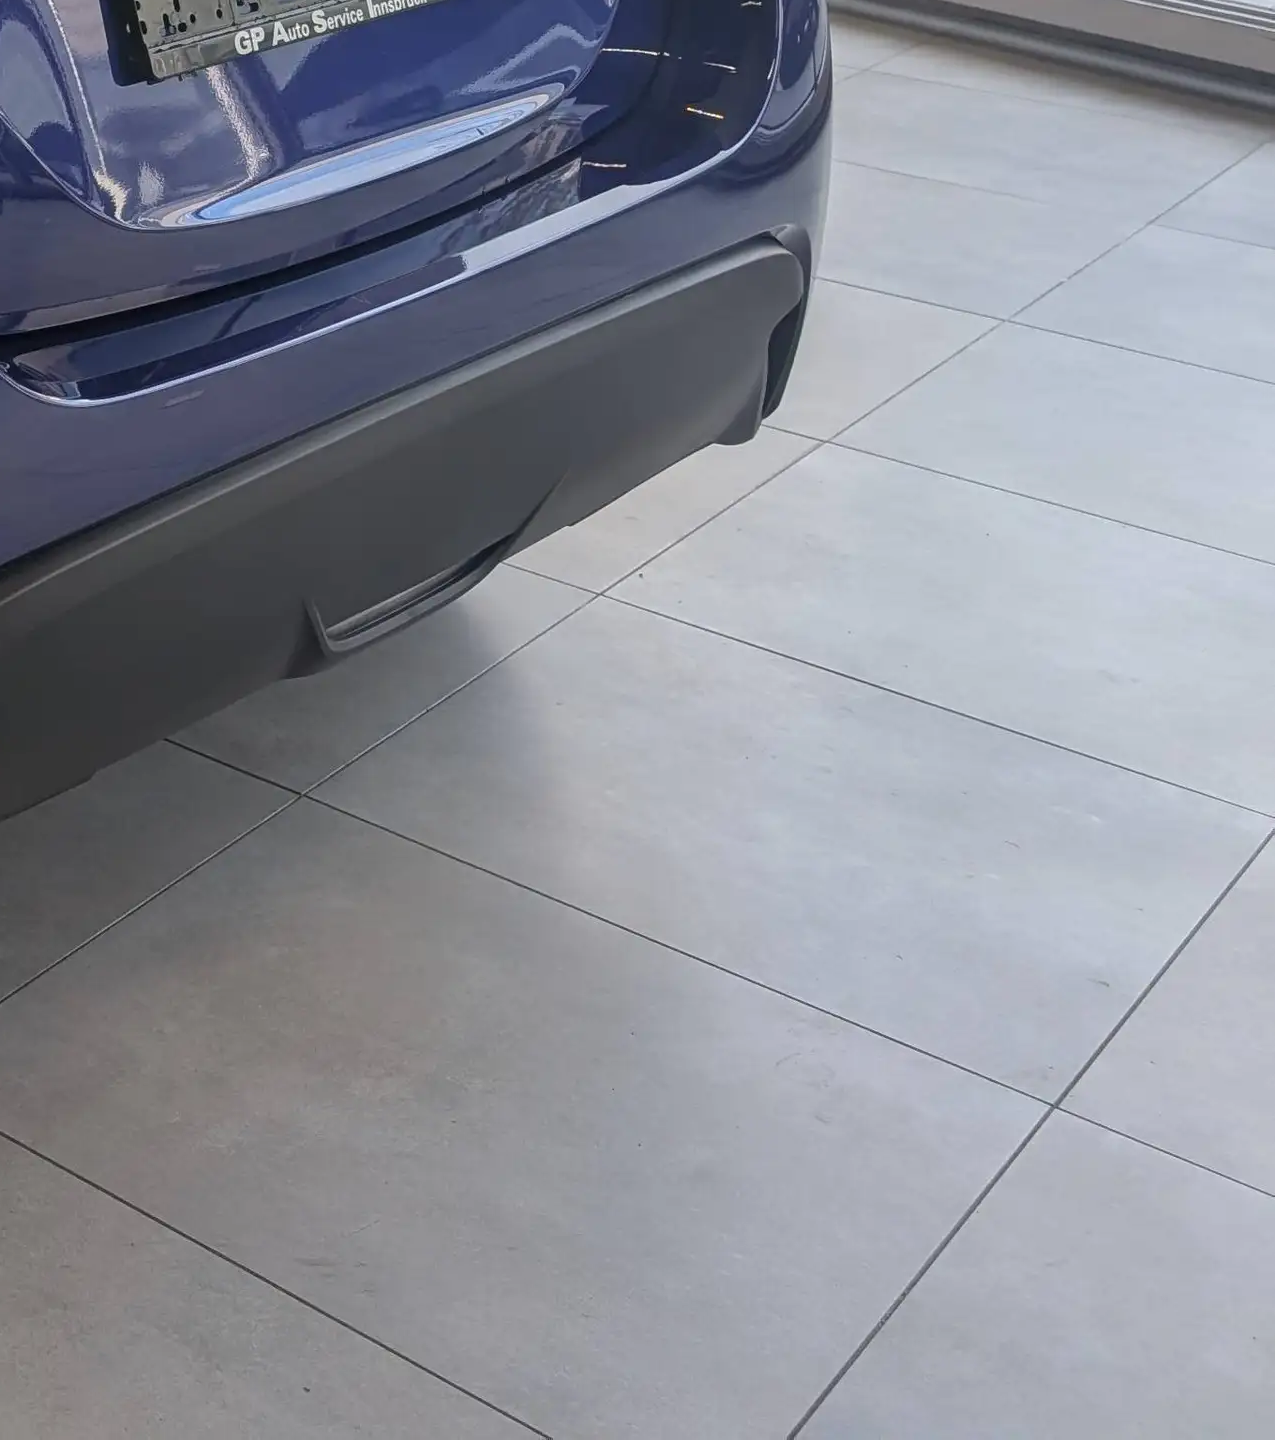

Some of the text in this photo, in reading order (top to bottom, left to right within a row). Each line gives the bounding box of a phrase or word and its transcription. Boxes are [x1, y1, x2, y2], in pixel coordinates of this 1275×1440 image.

[234, 25, 265, 55] GP
[271, 20, 310, 47] Auto
[311, 8, 364, 34] Service
